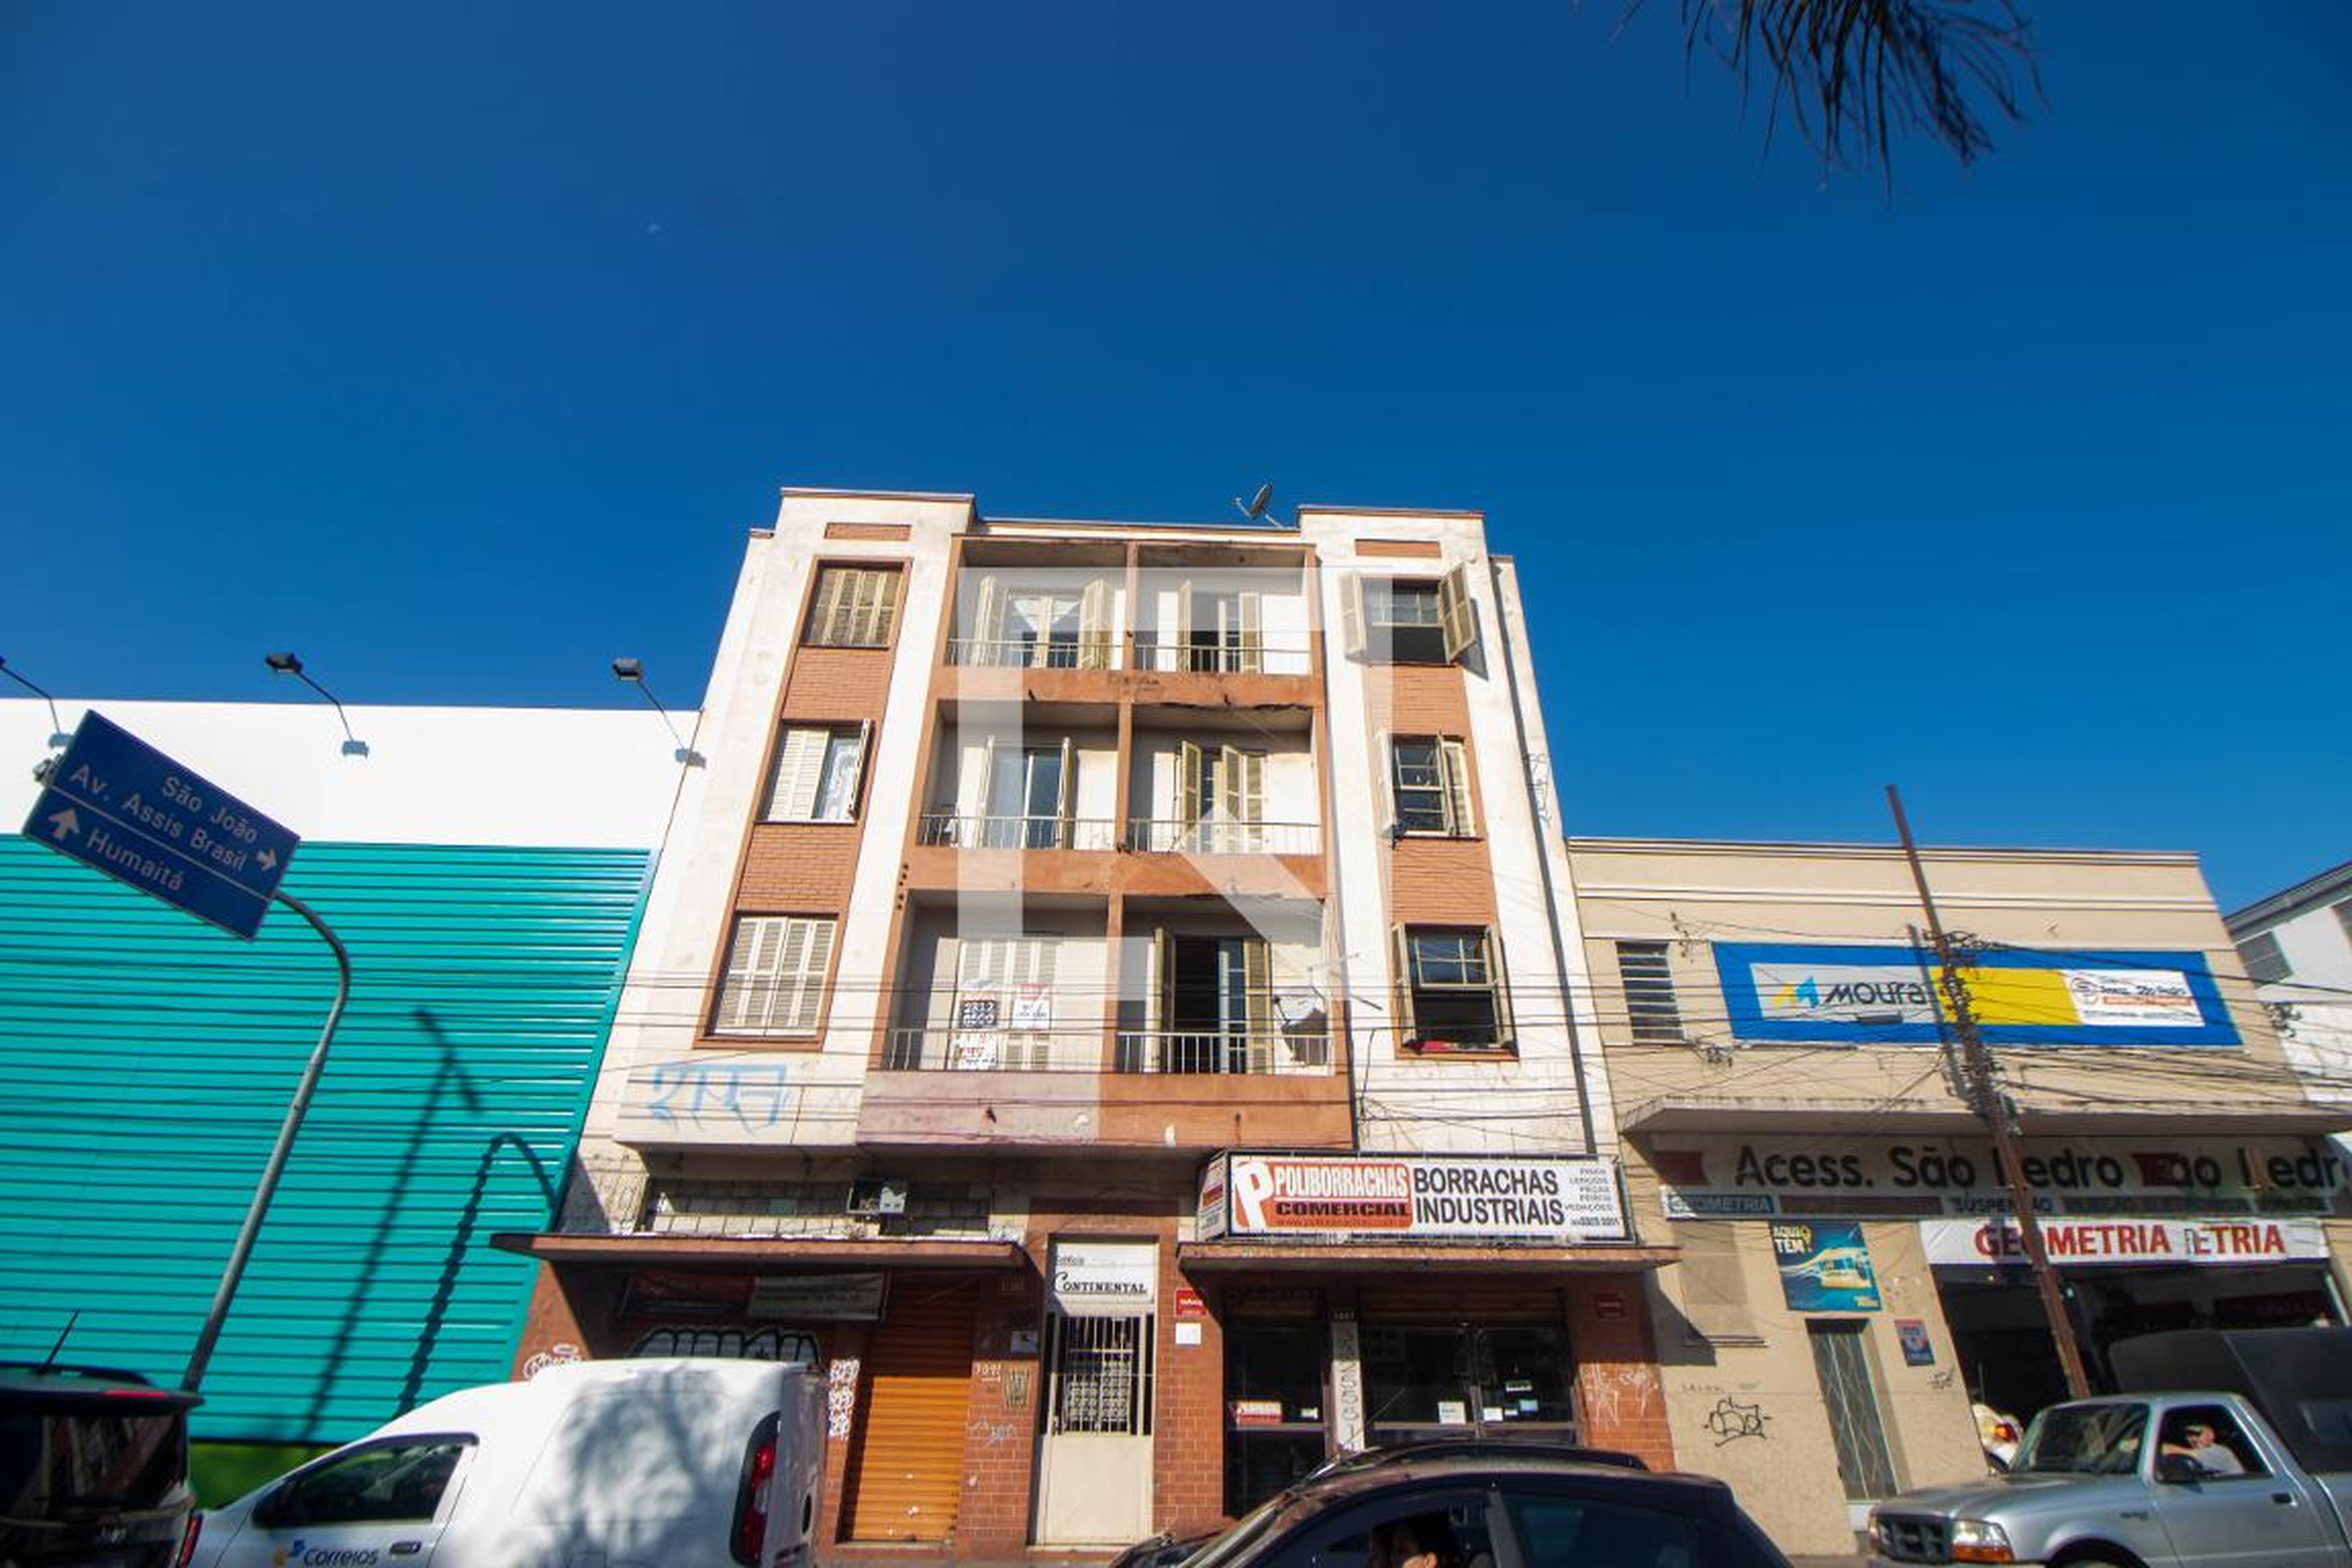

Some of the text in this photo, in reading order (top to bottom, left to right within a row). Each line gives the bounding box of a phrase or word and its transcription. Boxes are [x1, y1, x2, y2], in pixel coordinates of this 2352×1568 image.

[70, 763, 246, 873] Av. Assis Brasil
[162, 776, 258, 845] São João
[86, 827, 185, 891] Humaitá
[1275, 1166, 1408, 1197] POLIBORRACHAS
[1414, 1168, 1559, 1195] BORRACHAS
[1735, 1144, 1874, 1188] Acess.
[1888, 1145, 1976, 1189] São
[1275, 1202, 1410, 1216] COMERCIAL
[1416, 1198, 1565, 1225] INDUSTRIAIS
[1975, 1225, 2171, 1256] GEMETRIA
[304, 1548, 379, 1566] Correios
